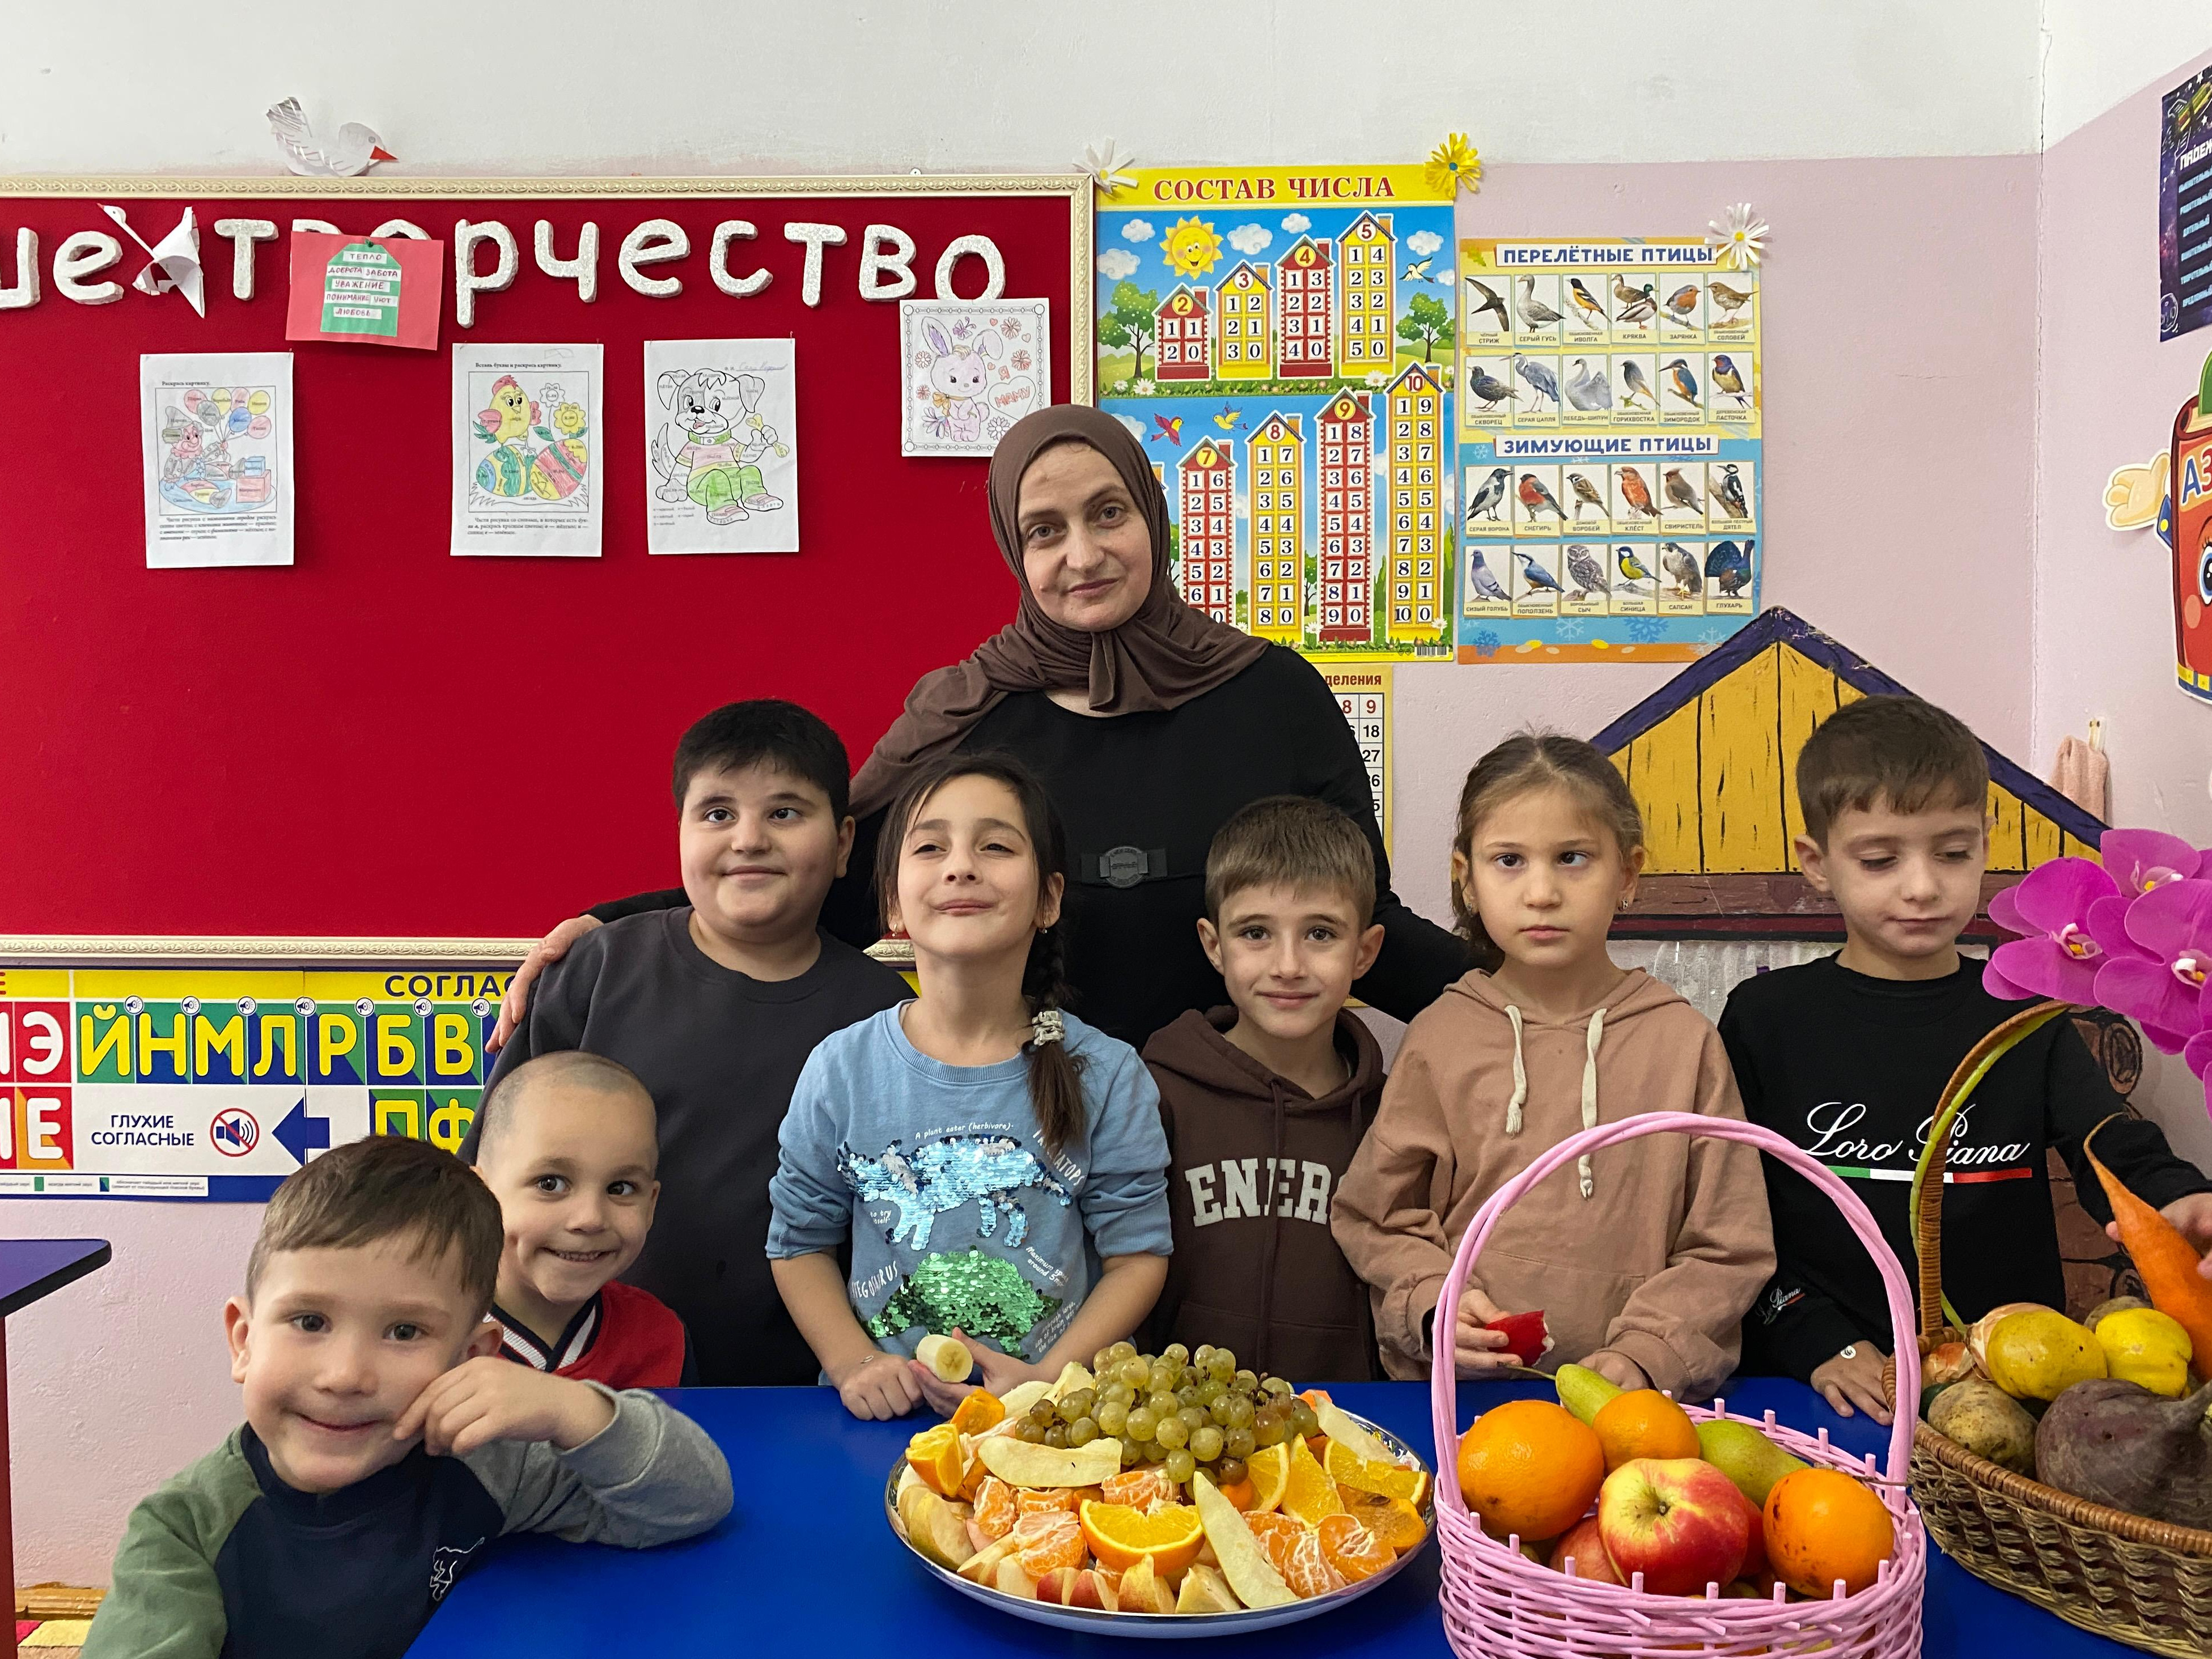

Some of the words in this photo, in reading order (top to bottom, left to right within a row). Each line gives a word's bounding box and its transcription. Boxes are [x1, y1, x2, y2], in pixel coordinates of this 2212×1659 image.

[1154, 178, 1276, 201] СОСТАВ
[1289, 176, 1395, 198] ЧИСЛА
[1361, 224, 1372, 239] 5
[1299, 249, 1311, 264] 4
[1353, 248, 1359, 261] 1
[1372, 248, 1384, 261] 4
[1504, 245, 1634, 264] ПЕРЕЛЁТНЫЕ
[1642, 247, 1713, 262] ПТИЦЫ
[214, 218, 1006, 329] трчество
[366, 269, 398, 277] ЗАБОТА
[1239, 273, 1249, 288] 3
[1291, 273, 1298, 286] 1
[1311, 273, 1322, 286] 3
[1351, 271, 1362, 285] 2
[1372, 271, 1383, 285] 3
[335, 279, 384, 290] УВАЖЕНИЕ
[1178, 297, 1188, 312] 2
[1230, 297, 1237, 311] 1
[1250, 296, 1260, 311] 2
[1289, 296, 1300, 310] 2
[1311, 296, 1321, 309] 2
[1351, 294, 1362, 308] 3
[1372, 294, 1383, 308] 2
[335, 308, 371, 316] ЛЮБОВЬ
[1168, 322, 1175, 336] 1
[1190, 321, 1196, 335] 1
[1228, 321, 1238, 334] 2
[1251, 321, 1258, 334] 1
[1289, 319, 1300, 333] 3
[1313, 319, 1320, 332] 1
[1351, 319, 1362, 332] 4
[1374, 318, 1382, 332] 1
[1167, 346, 1177, 359] 2
[1188, 345, 1199, 359] 0
[1228, 345, 1239, 358] 3
[1249, 344, 1260, 358] 0
[1289, 343, 1300, 357] 4
[1311, 342, 1322, 357] 0
[1351, 342, 1362, 356] 5
[1372, 341, 1384, 356] 0
[998, 365, 1010, 381] Я
[1407, 375, 1423, 392] 10
[994, 386, 1031, 408] МАМУ
[1340, 401, 1350, 417] 9
[1400, 400, 1408, 413] 1
[1421, 399, 1431, 413] 9
[1270, 425, 1281, 440] 8
[1330, 427, 1337, 439] 1
[1351, 426, 1362, 439] 8
[1504, 438, 1631, 453] ЗИМУЮЩИЕ
[1639, 437, 1711, 452] ПТИЦЫ
[1202, 450, 1211, 465] 7
[1213, 610, 1223, 623] 0
[1324, 674, 1382, 686] деления
[1342, 699, 1352, 714] 8
[1366, 699, 1376, 714] 9
[1363, 725, 1380, 738] 18
[1362, 749, 1380, 762] 27
[1370, 774, 1380, 787] 6
[23, 1011, 64, 1075] Э
[80, 1004, 130, 1077] Й
[139, 1012, 187, 1076] Н
[196, 1012, 244, 1076] М
[253, 1013, 296, 1077] Л
[319, 1013, 357, 1076] Р
[377, 1014, 416, 1076] Б
[434, 1013, 474, 1075] В
[27, 1097, 63, 1160] Е
[375, 1100, 419, 1140] П
[429, 1098, 475, 1155] Ф
[111, 1114, 174, 1129] ГЛУХИЕ
[924, 1127, 942, 1140] plant
[1800, 1101, 1903, 1161] Loro
[91, 1131, 195, 1147] СОГЛАСНЫЕ
[880, 1210, 892, 1219] try
[1026, 1246, 1054, 1271] Maximum
[1028, 1259, 1049, 1276] around
